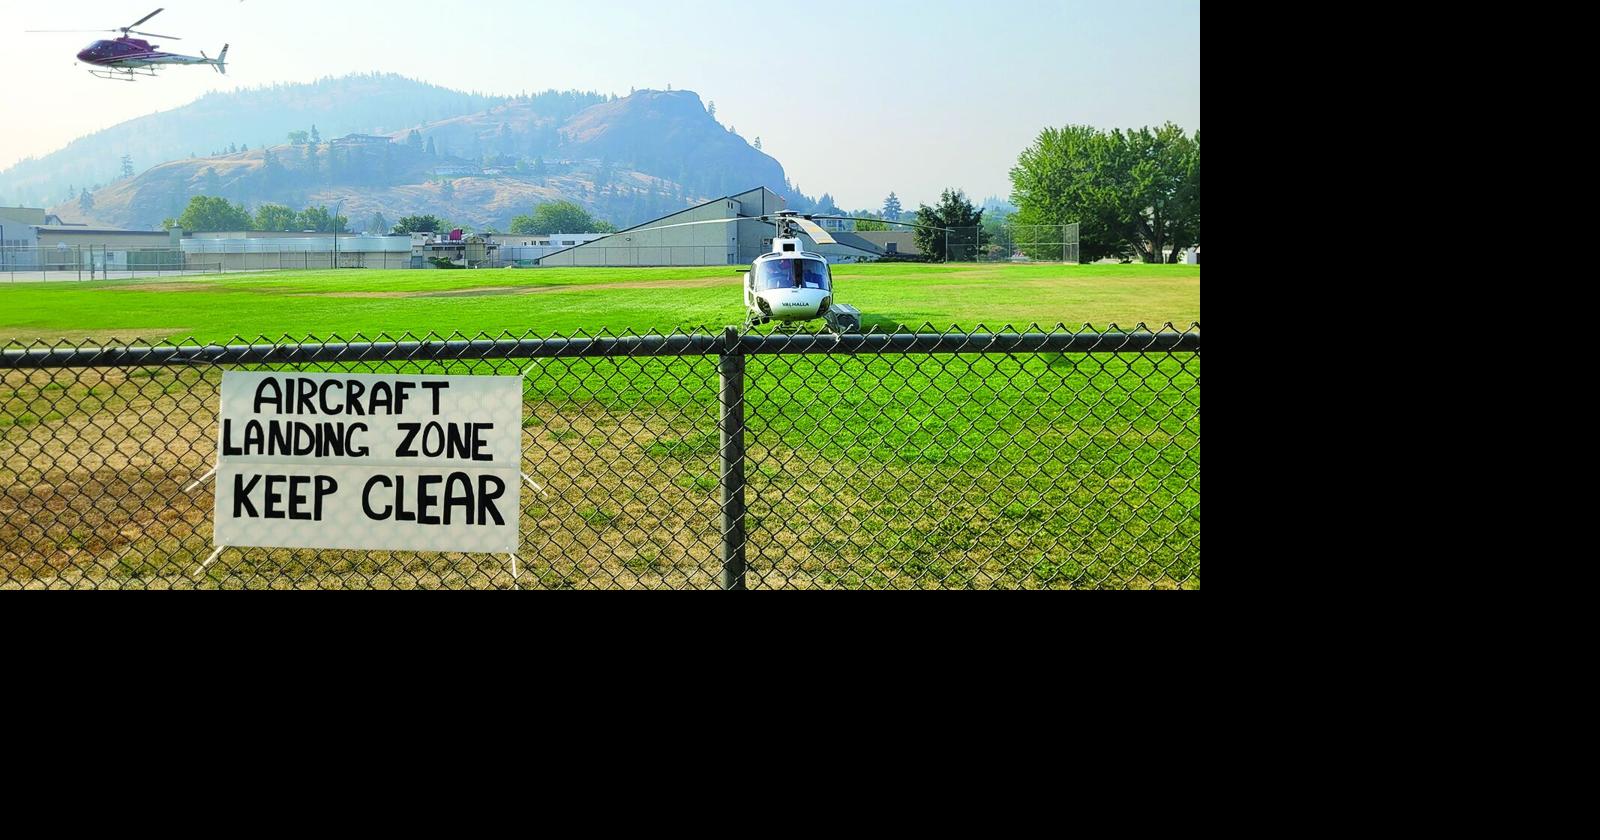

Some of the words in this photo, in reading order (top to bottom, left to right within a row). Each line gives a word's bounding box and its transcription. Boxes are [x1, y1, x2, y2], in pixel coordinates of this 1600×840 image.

[253, 376, 450, 416] AIRCRAFT
[222, 418, 370, 458] LANDING
[395, 420, 494, 462] ZONE
[232, 473, 338, 522] KEEP
[361, 471, 506, 526] CLEAR
